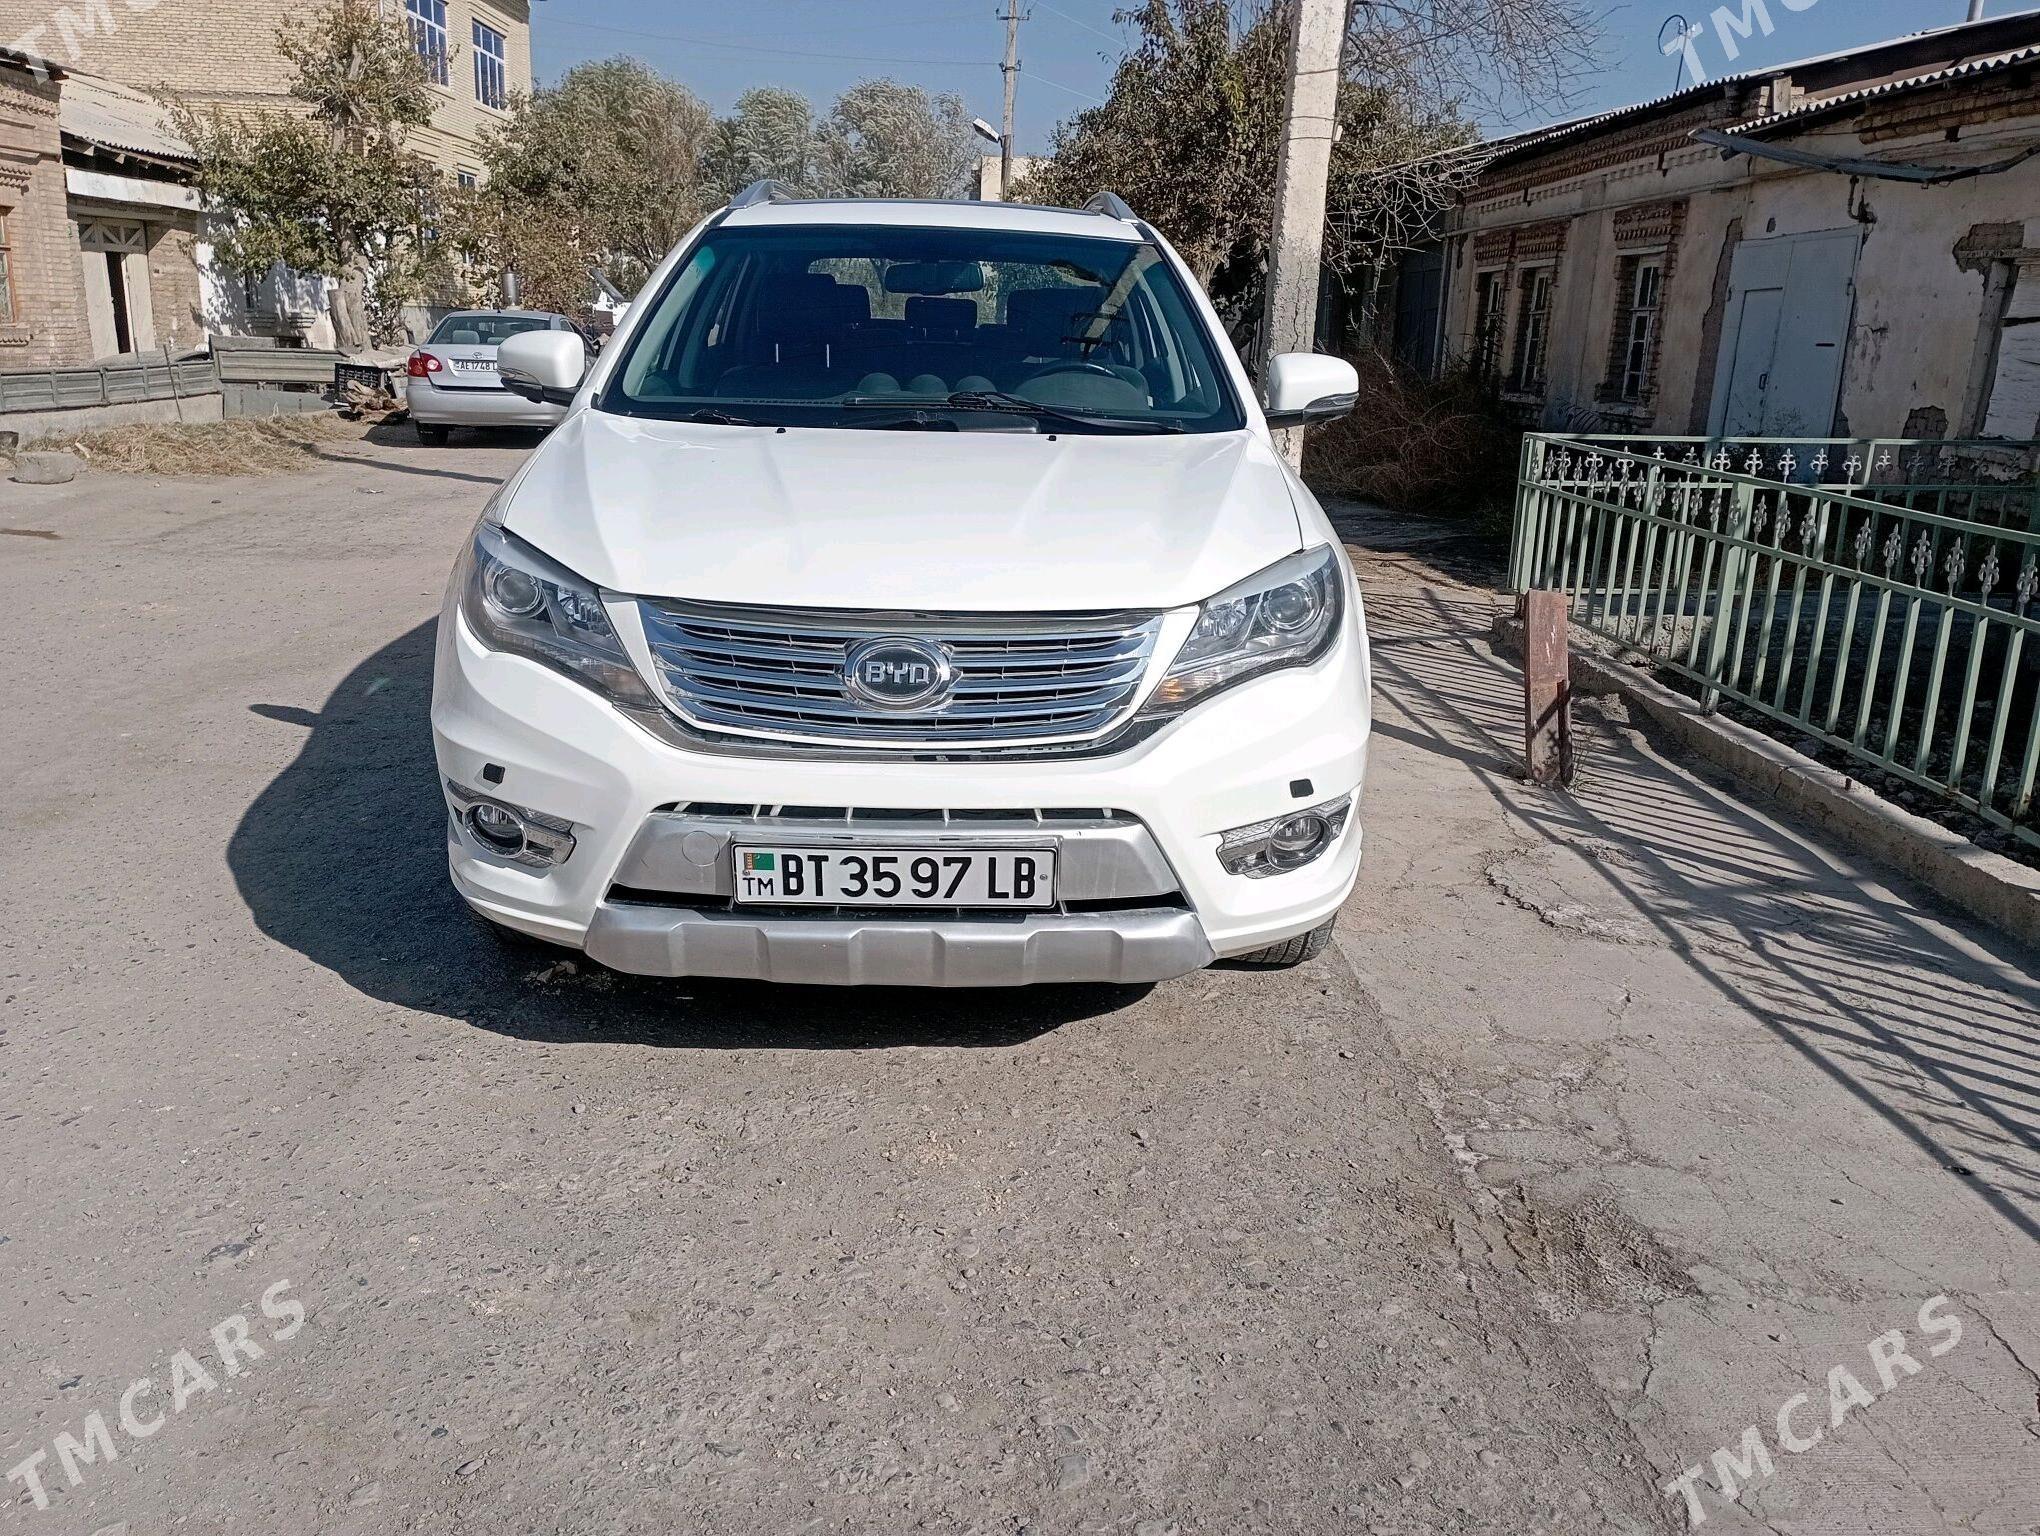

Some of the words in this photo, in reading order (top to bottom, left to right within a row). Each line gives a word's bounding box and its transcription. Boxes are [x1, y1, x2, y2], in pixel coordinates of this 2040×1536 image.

[460, 361, 469, 370] AE
[865, 661, 930, 684] BYD
[742, 877, 774, 896] TM
[781, 854, 829, 897] BT
[839, 855, 972, 899] 3597
[987, 856, 1036, 899] LB
